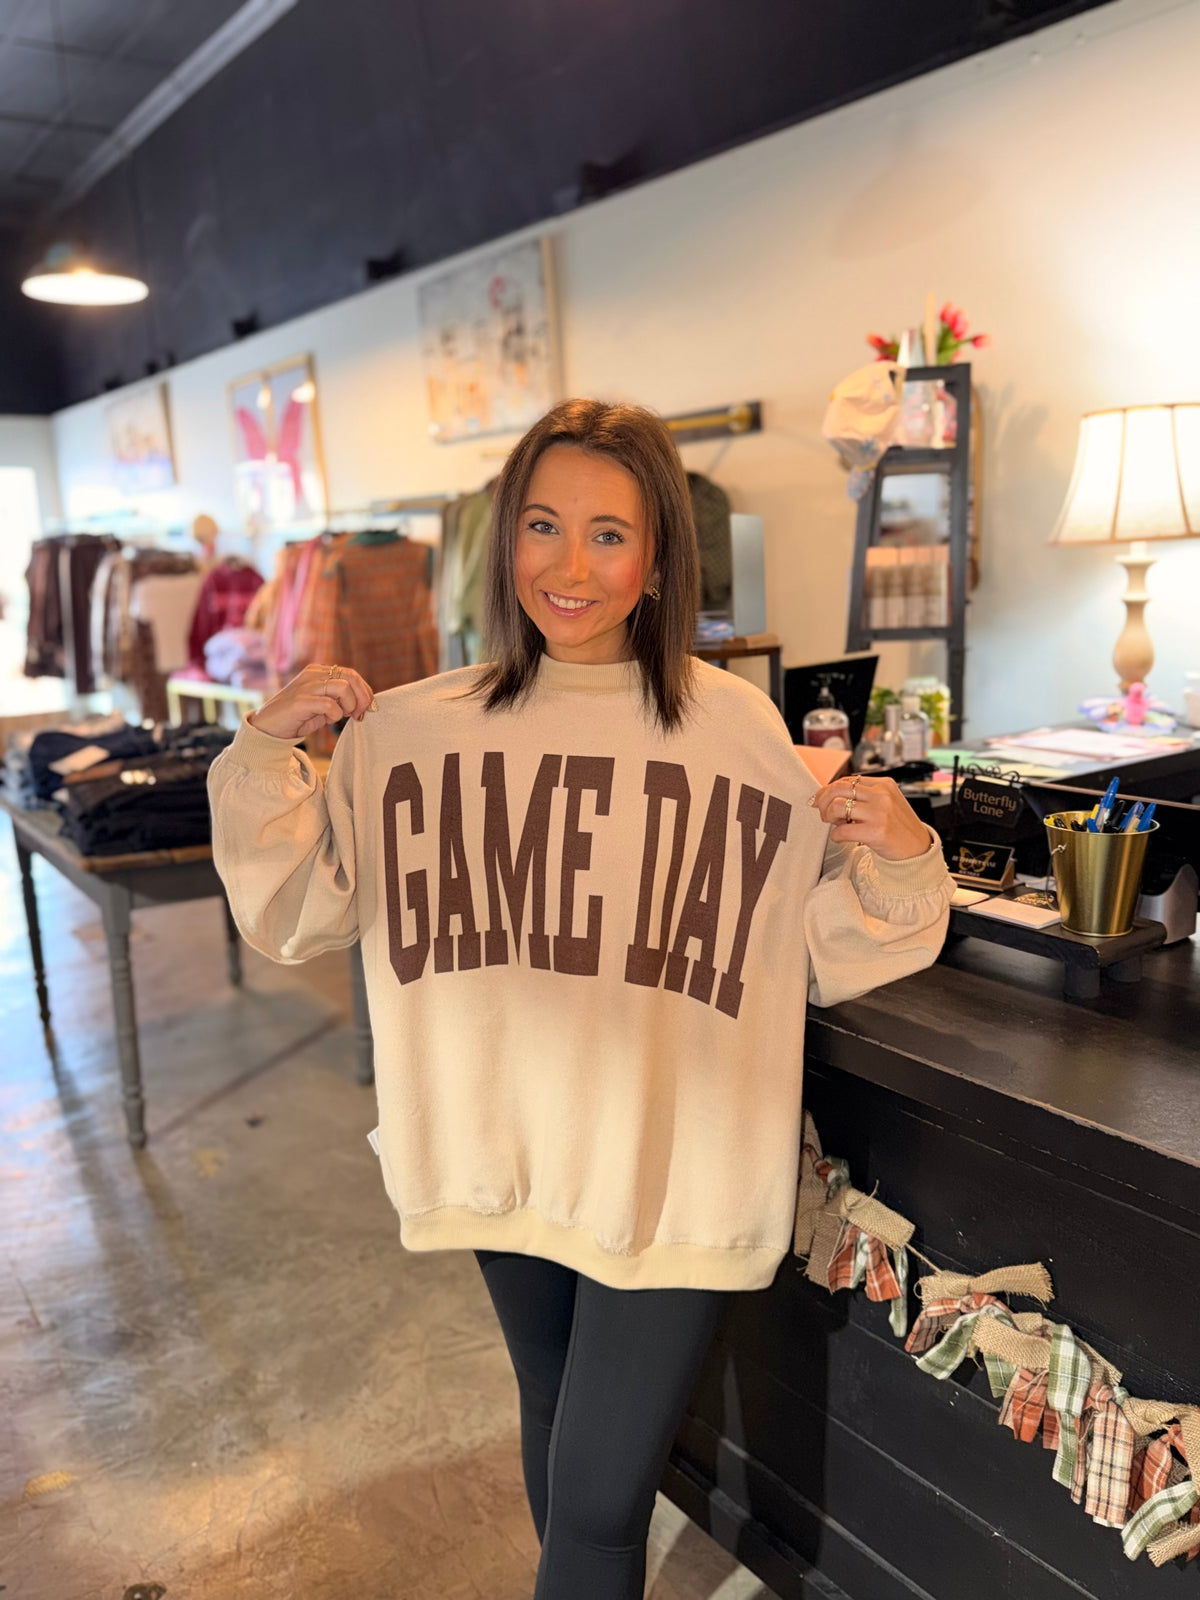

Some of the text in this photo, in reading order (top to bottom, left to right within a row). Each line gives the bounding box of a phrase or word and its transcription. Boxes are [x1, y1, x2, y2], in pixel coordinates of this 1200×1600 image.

[963, 788, 1016, 811] Butterfly
[973, 802, 1004, 818] Lane
[383, 752, 792, 1019] GAME DAY
